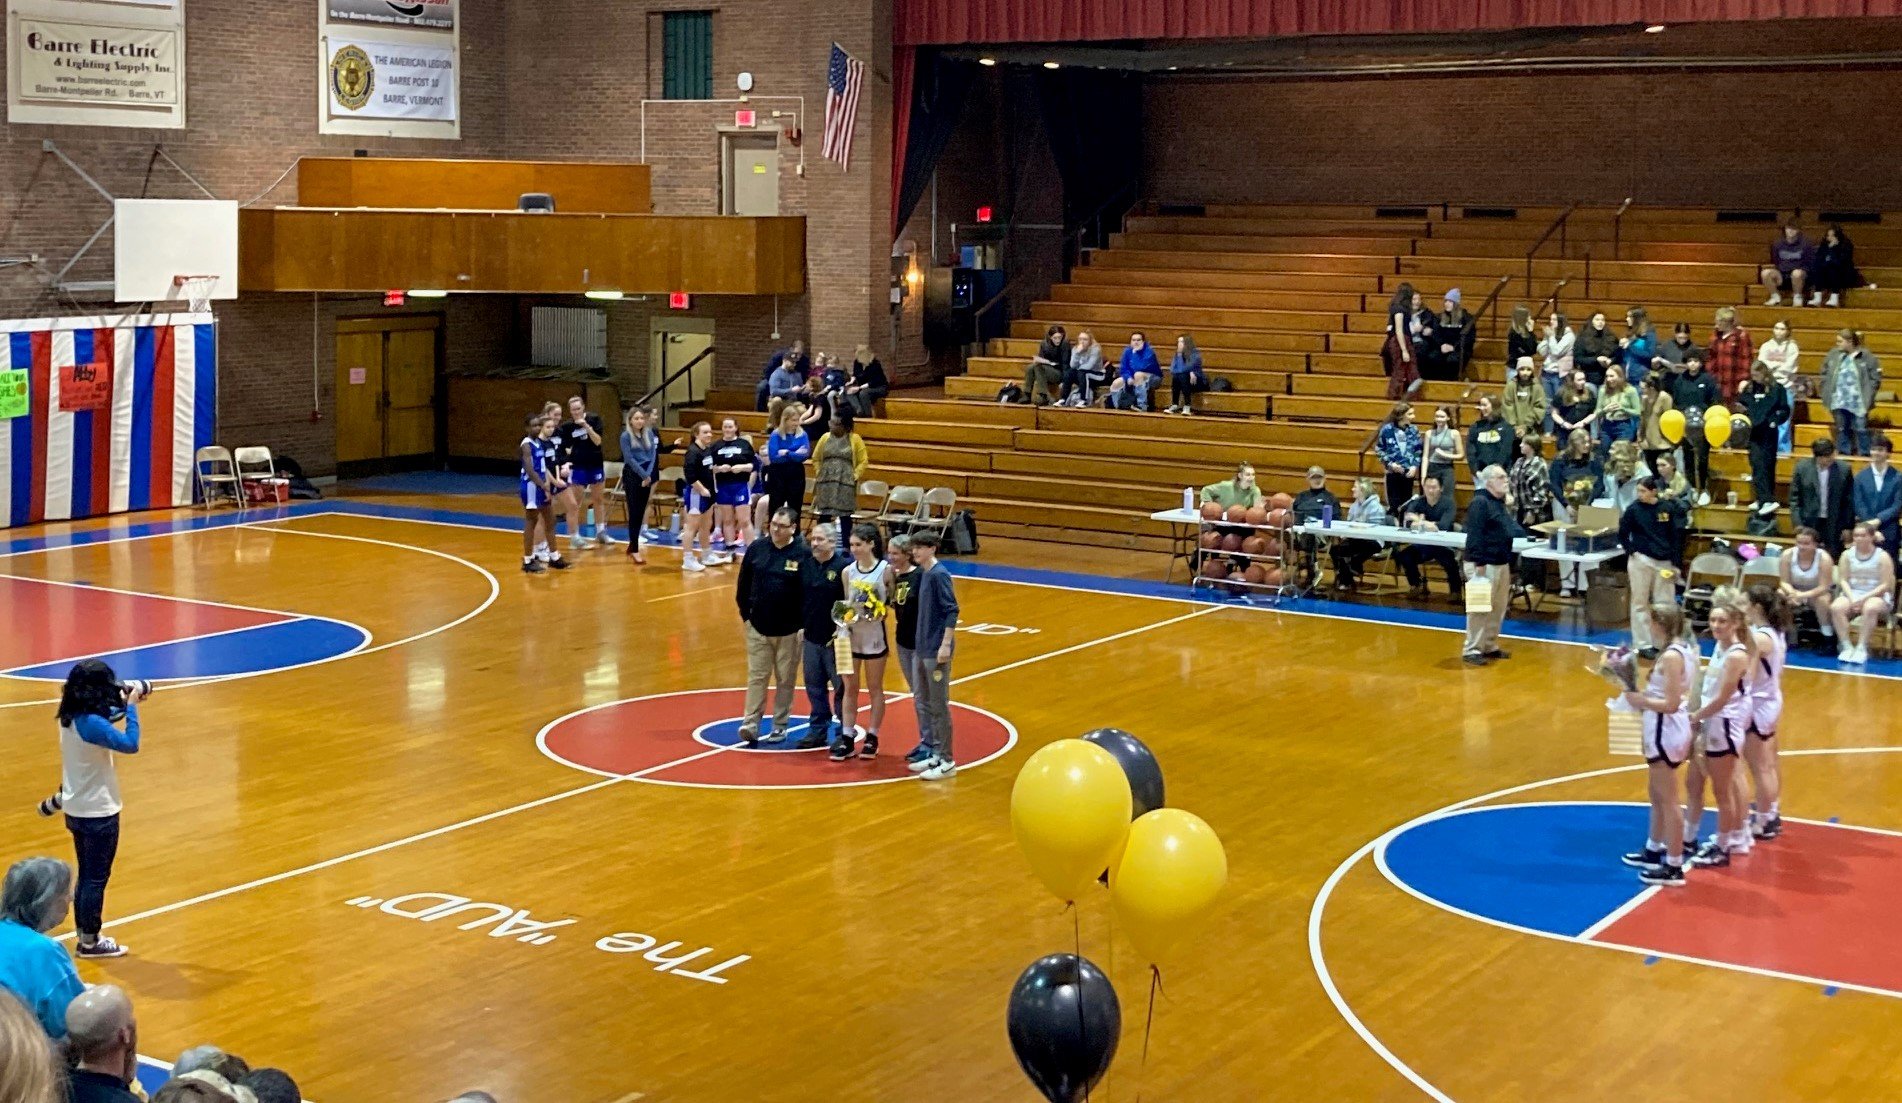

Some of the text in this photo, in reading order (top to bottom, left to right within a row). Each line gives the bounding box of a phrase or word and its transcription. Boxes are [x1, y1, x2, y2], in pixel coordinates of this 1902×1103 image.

[27, 32, 160, 59] Barre Electric
[54, 57, 62, 67] &
[67, 58, 110, 72] Lighting
[375, 55, 452, 69] THE AMERICAN LEGION
[55, 75, 146, 87] www.barreelectric.com
[388, 77, 411, 87] BARRE
[412, 78, 429, 88] POST
[35, 84, 102, 97] Barre-Montpelier
[154, 91, 165, 99] VT
[383, 95, 443, 106] BARRE, VERMONT
[594, 932, 752, 985] The
